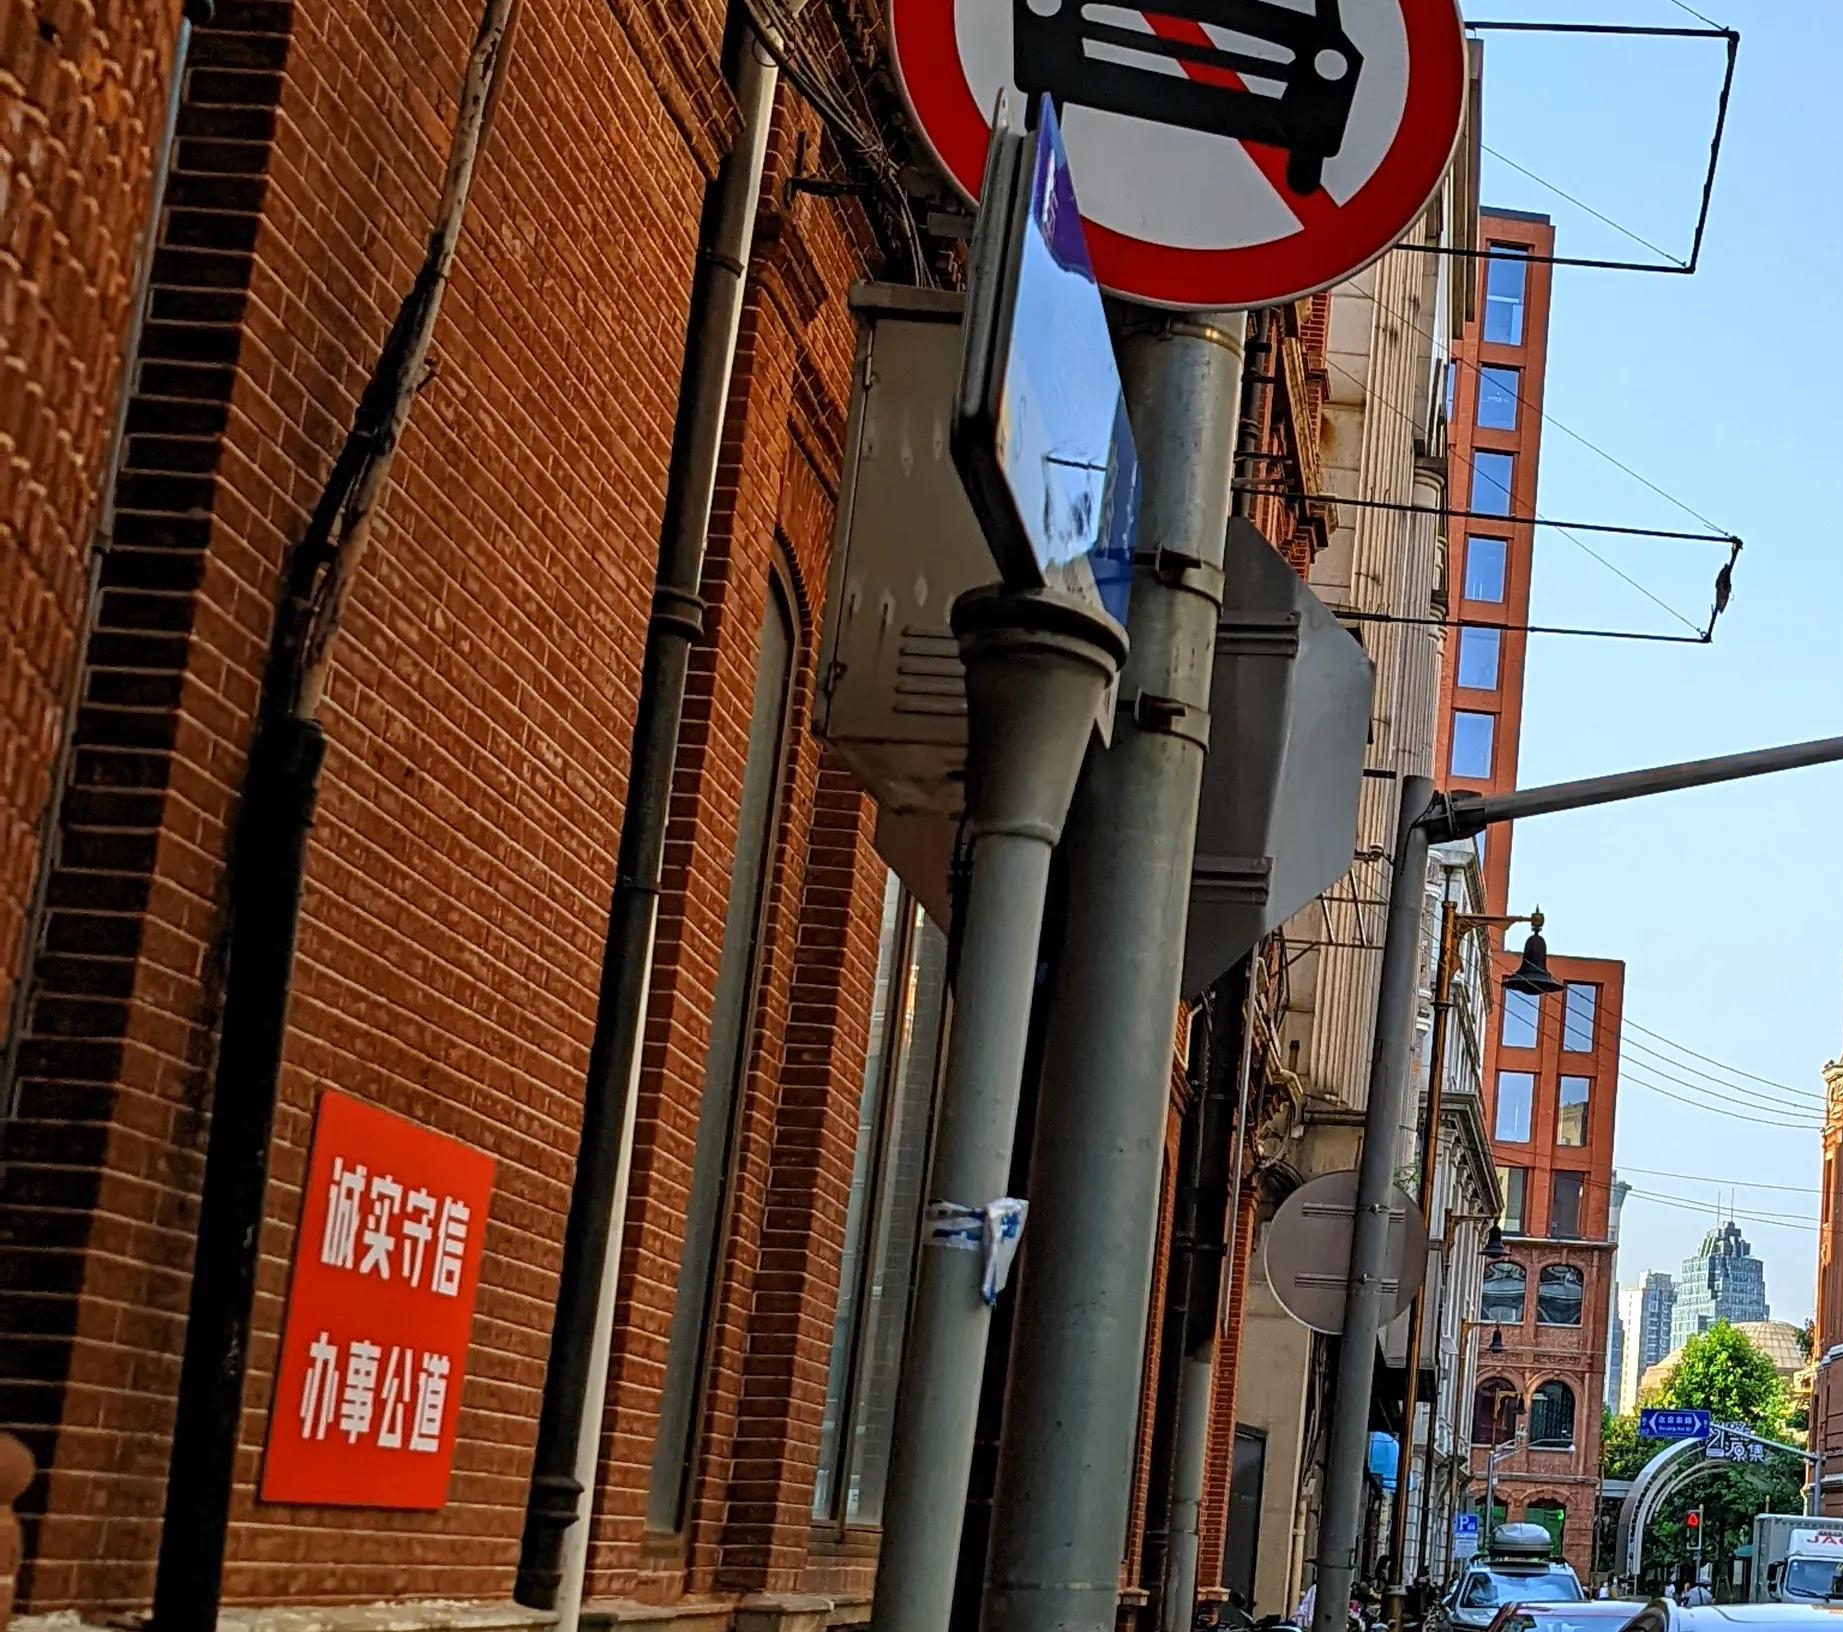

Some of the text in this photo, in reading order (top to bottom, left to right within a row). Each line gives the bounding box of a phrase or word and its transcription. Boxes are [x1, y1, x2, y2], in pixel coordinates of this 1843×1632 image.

[321, 1156, 470, 1297] 诚实守信
[300, 1331, 450, 1453] 办事公道
